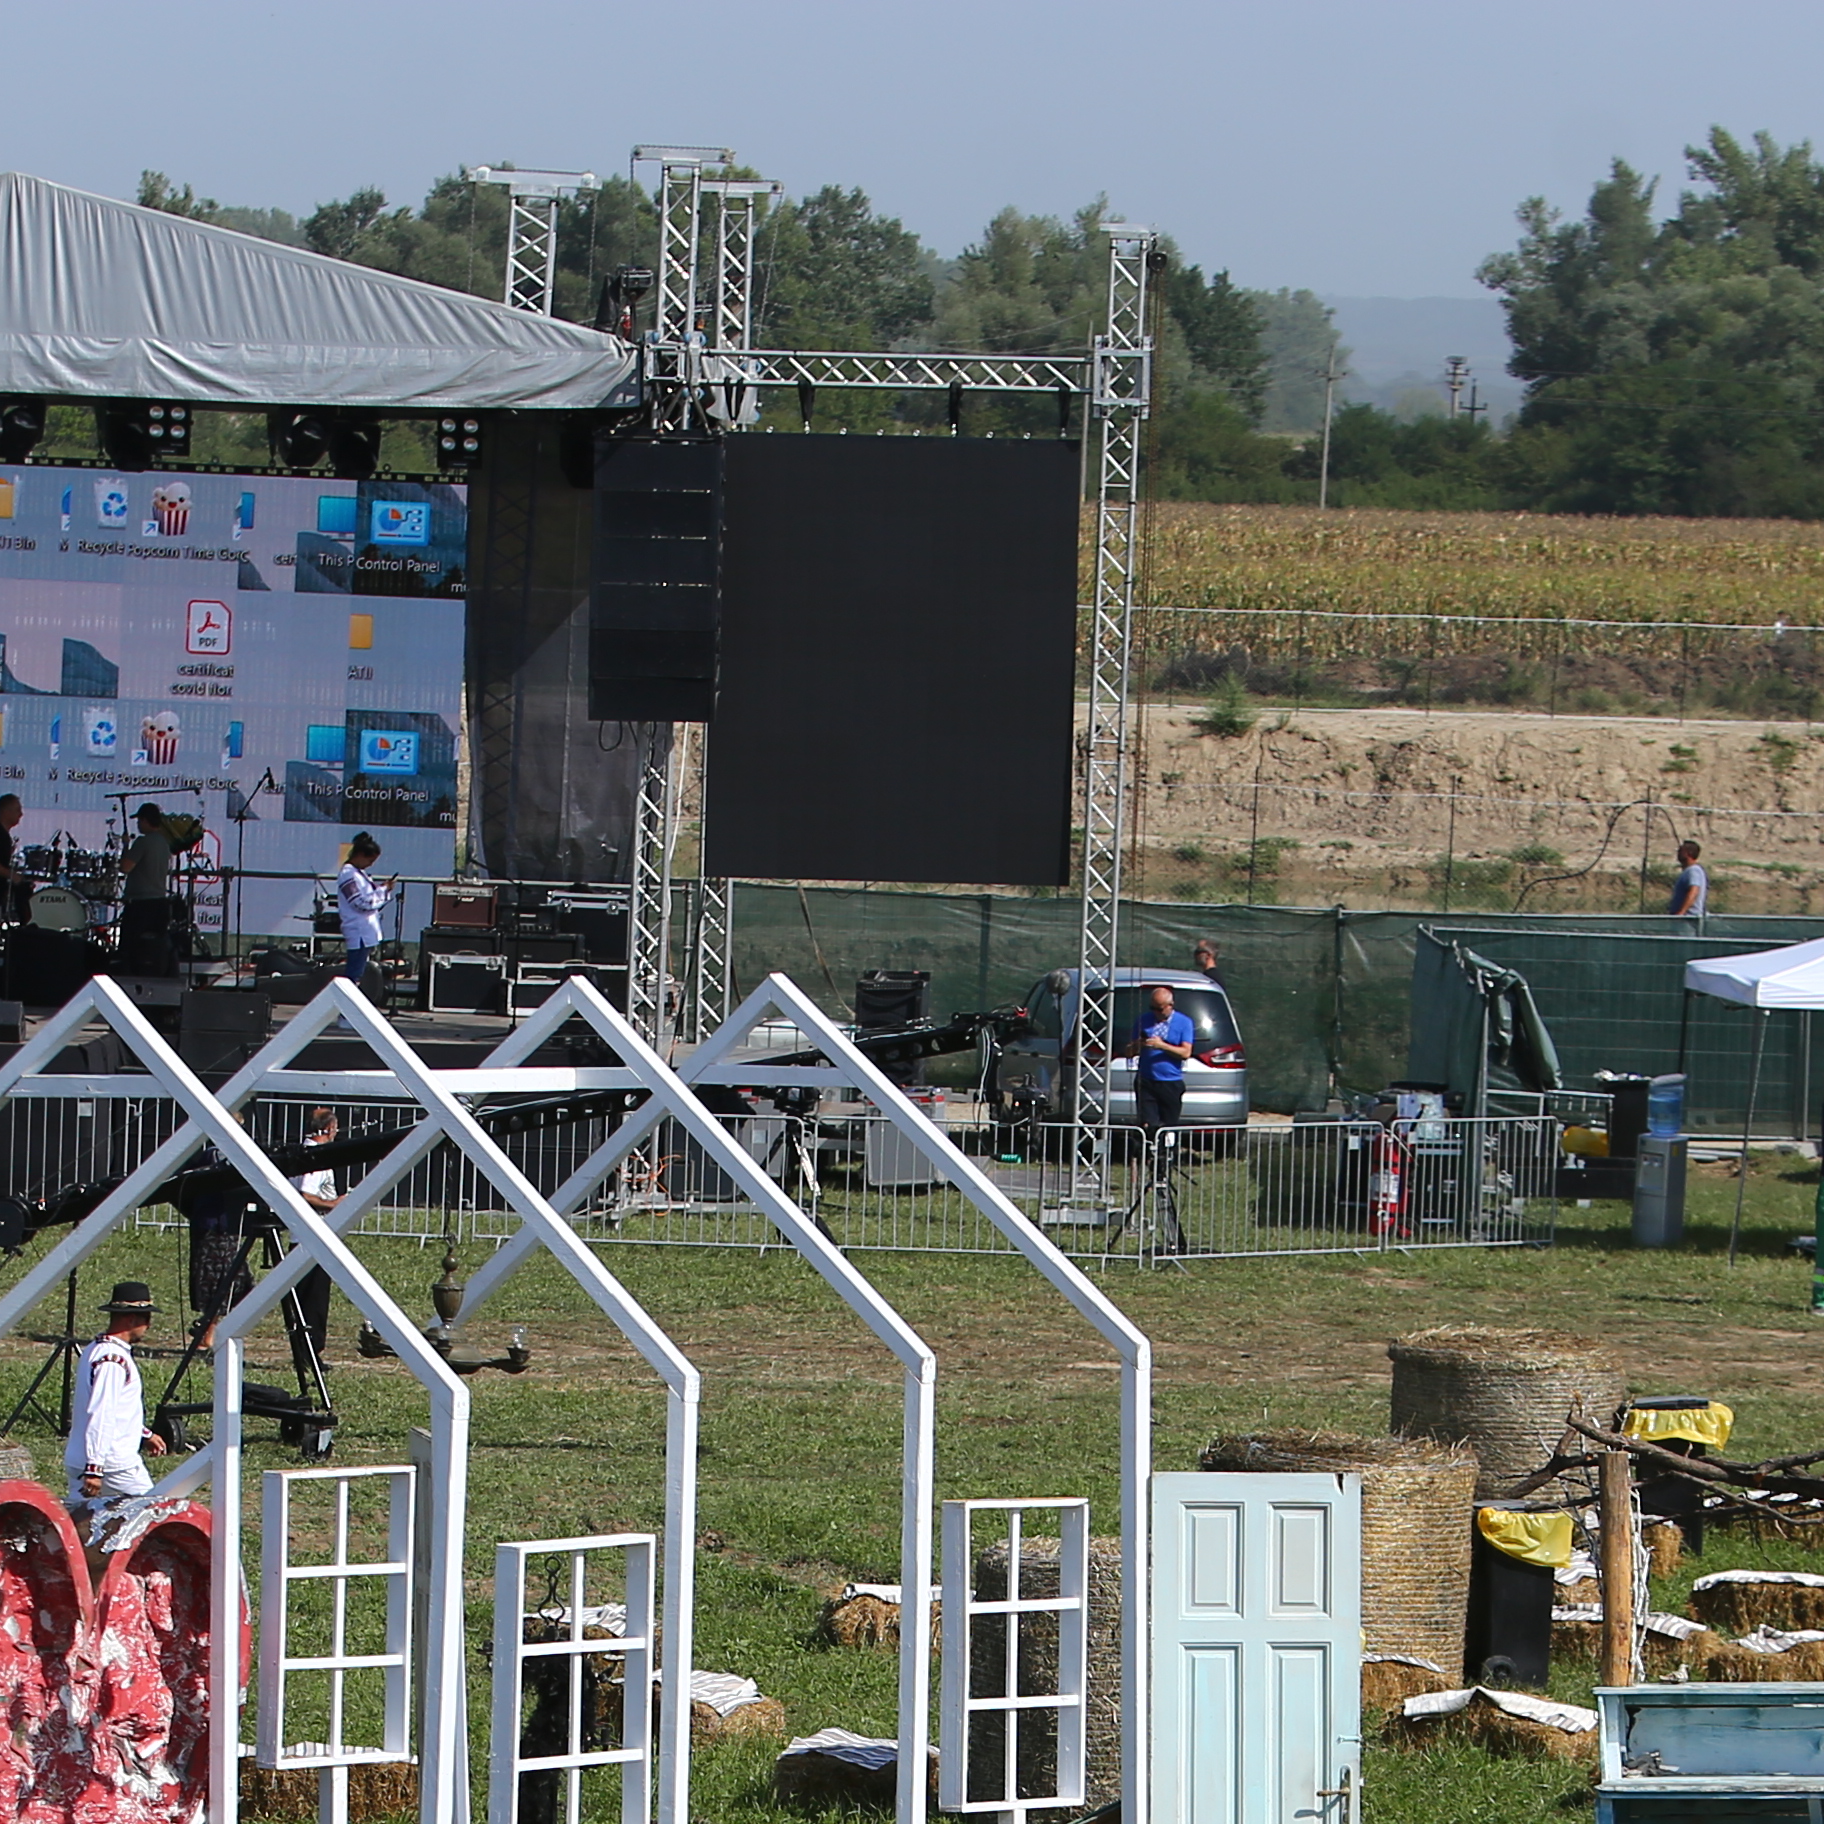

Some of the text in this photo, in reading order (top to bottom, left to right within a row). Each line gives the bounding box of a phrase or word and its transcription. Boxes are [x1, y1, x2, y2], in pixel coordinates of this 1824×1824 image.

[77, 538, 125, 557] Recycle
[127, 544, 180, 560] Popcorn
[183, 545, 214, 560] Time
[319, 553, 343, 567] This
[356, 557, 441, 573] Control Panel
[199, 637, 218, 647] PDF
[66, 768, 114, 786] Recycle
[117, 773, 169, 788] Popcorn
[172, 774, 204, 789] Time
[307, 782, 332, 796] This
[345, 786, 429, 802] Control Panel
